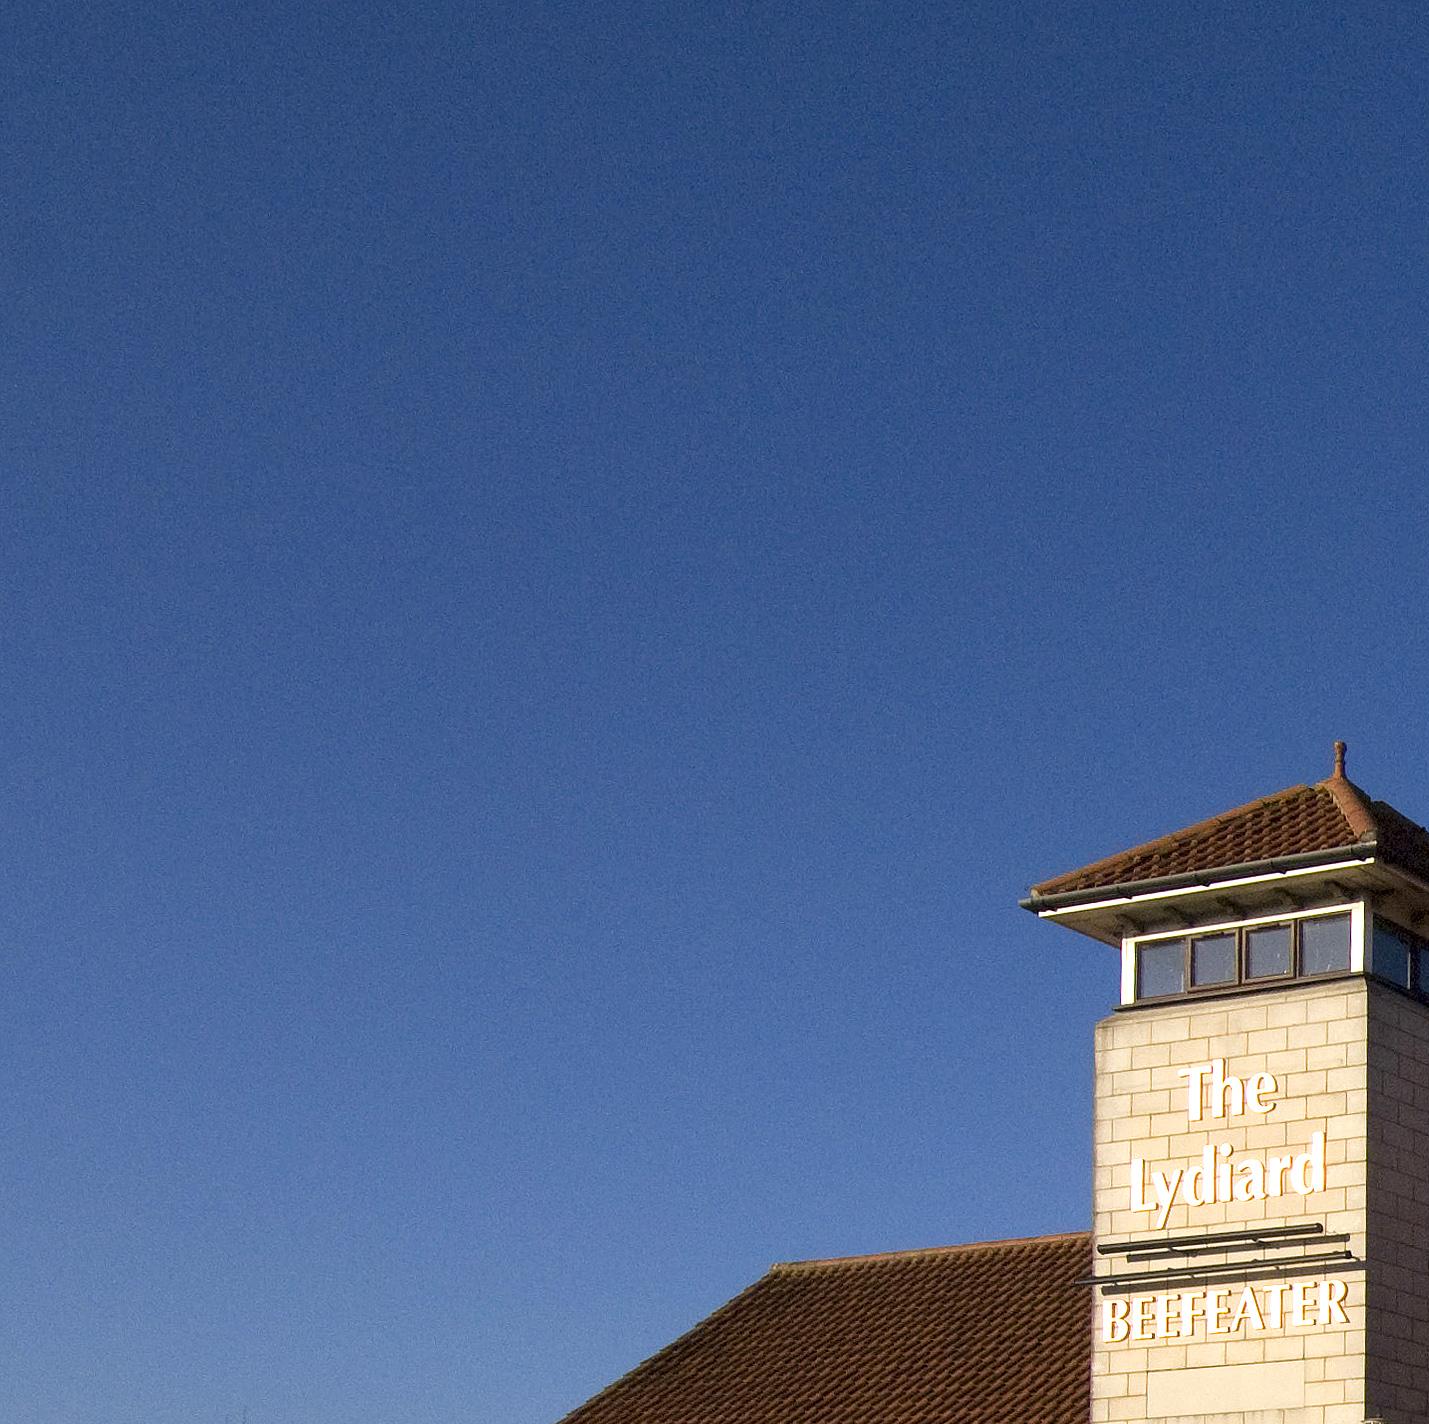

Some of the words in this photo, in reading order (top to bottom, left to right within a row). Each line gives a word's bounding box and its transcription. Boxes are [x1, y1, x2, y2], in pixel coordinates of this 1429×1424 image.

[1177, 1057, 1277, 1122] The
[1130, 1130, 1328, 1230] Lydiard
[1101, 1279, 1351, 1344] BEEFEATER
